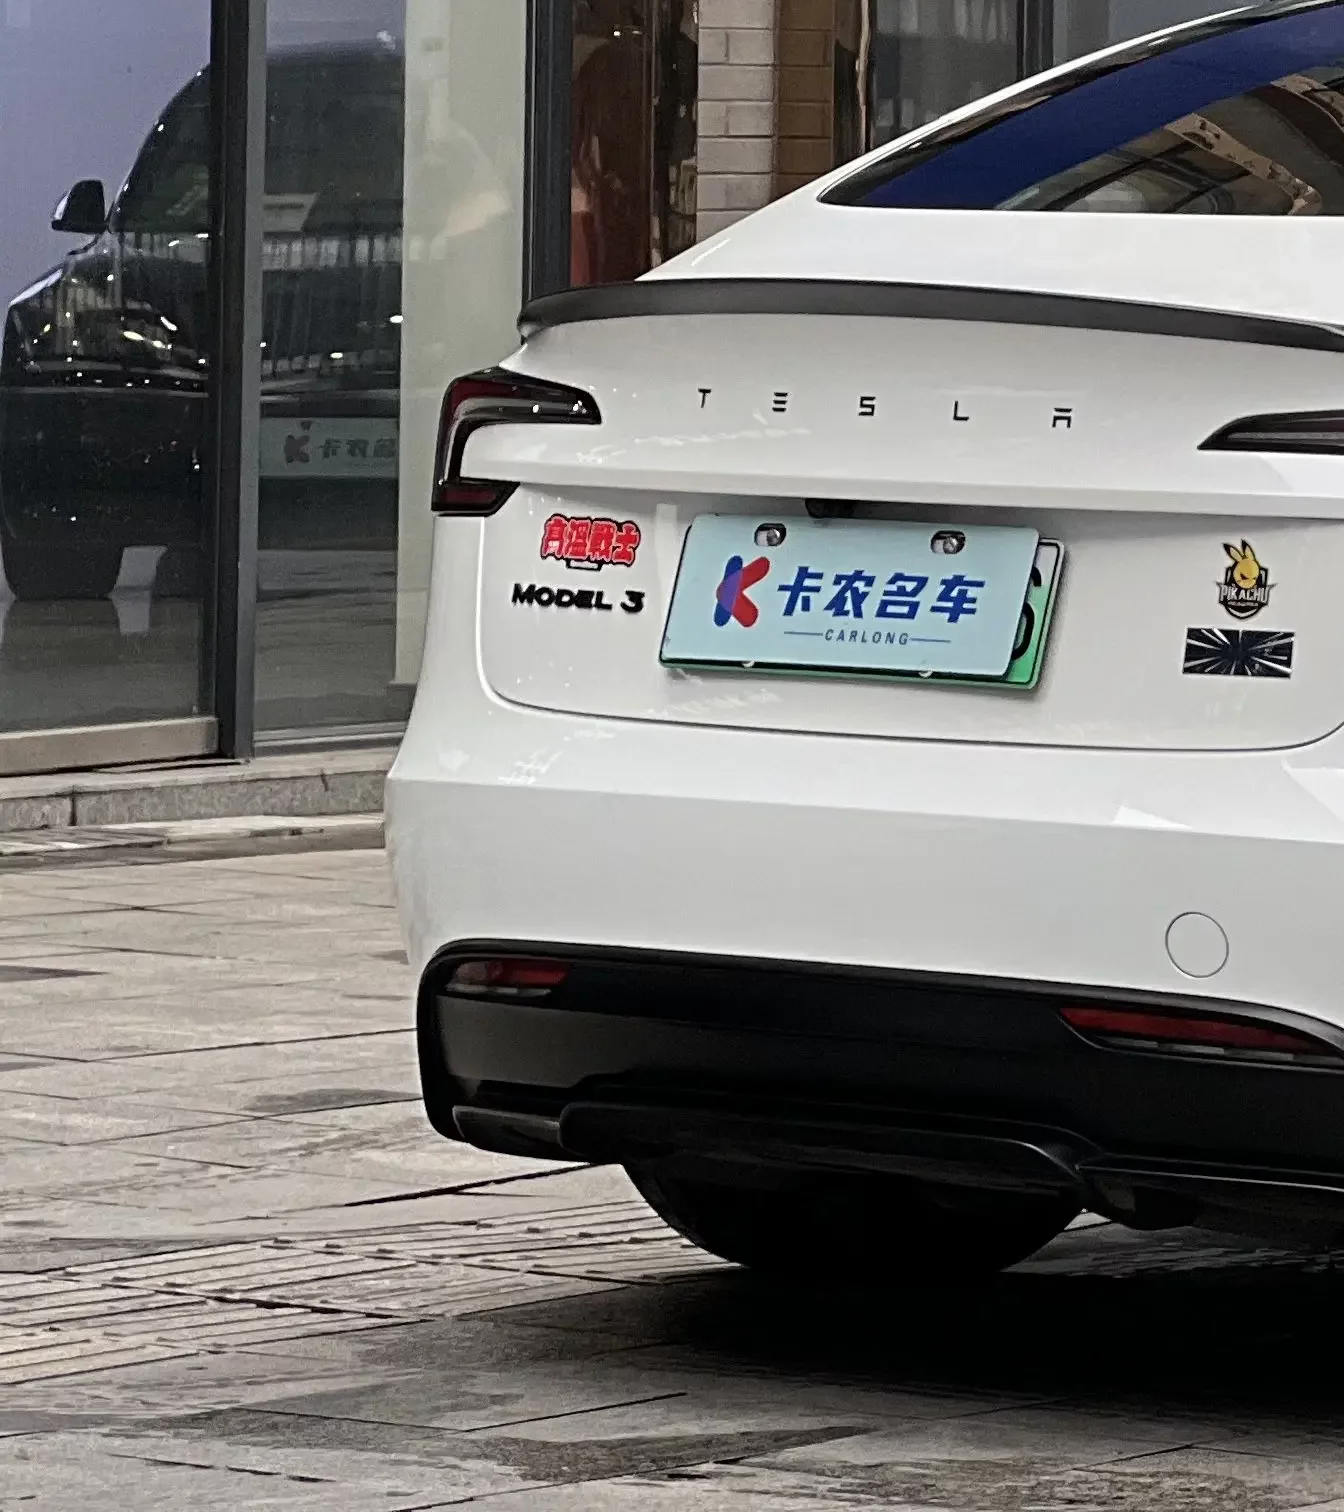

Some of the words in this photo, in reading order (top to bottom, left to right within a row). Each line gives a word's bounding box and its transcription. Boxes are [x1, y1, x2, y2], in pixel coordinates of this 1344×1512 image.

[697, 388, 1073, 428] TESLA
[512, 583, 613, 610] MODEL
[620, 590, 645, 613] 3
[777, 565, 986, 624] 卡农名车
[824, 629, 910, 646] CARLONG
